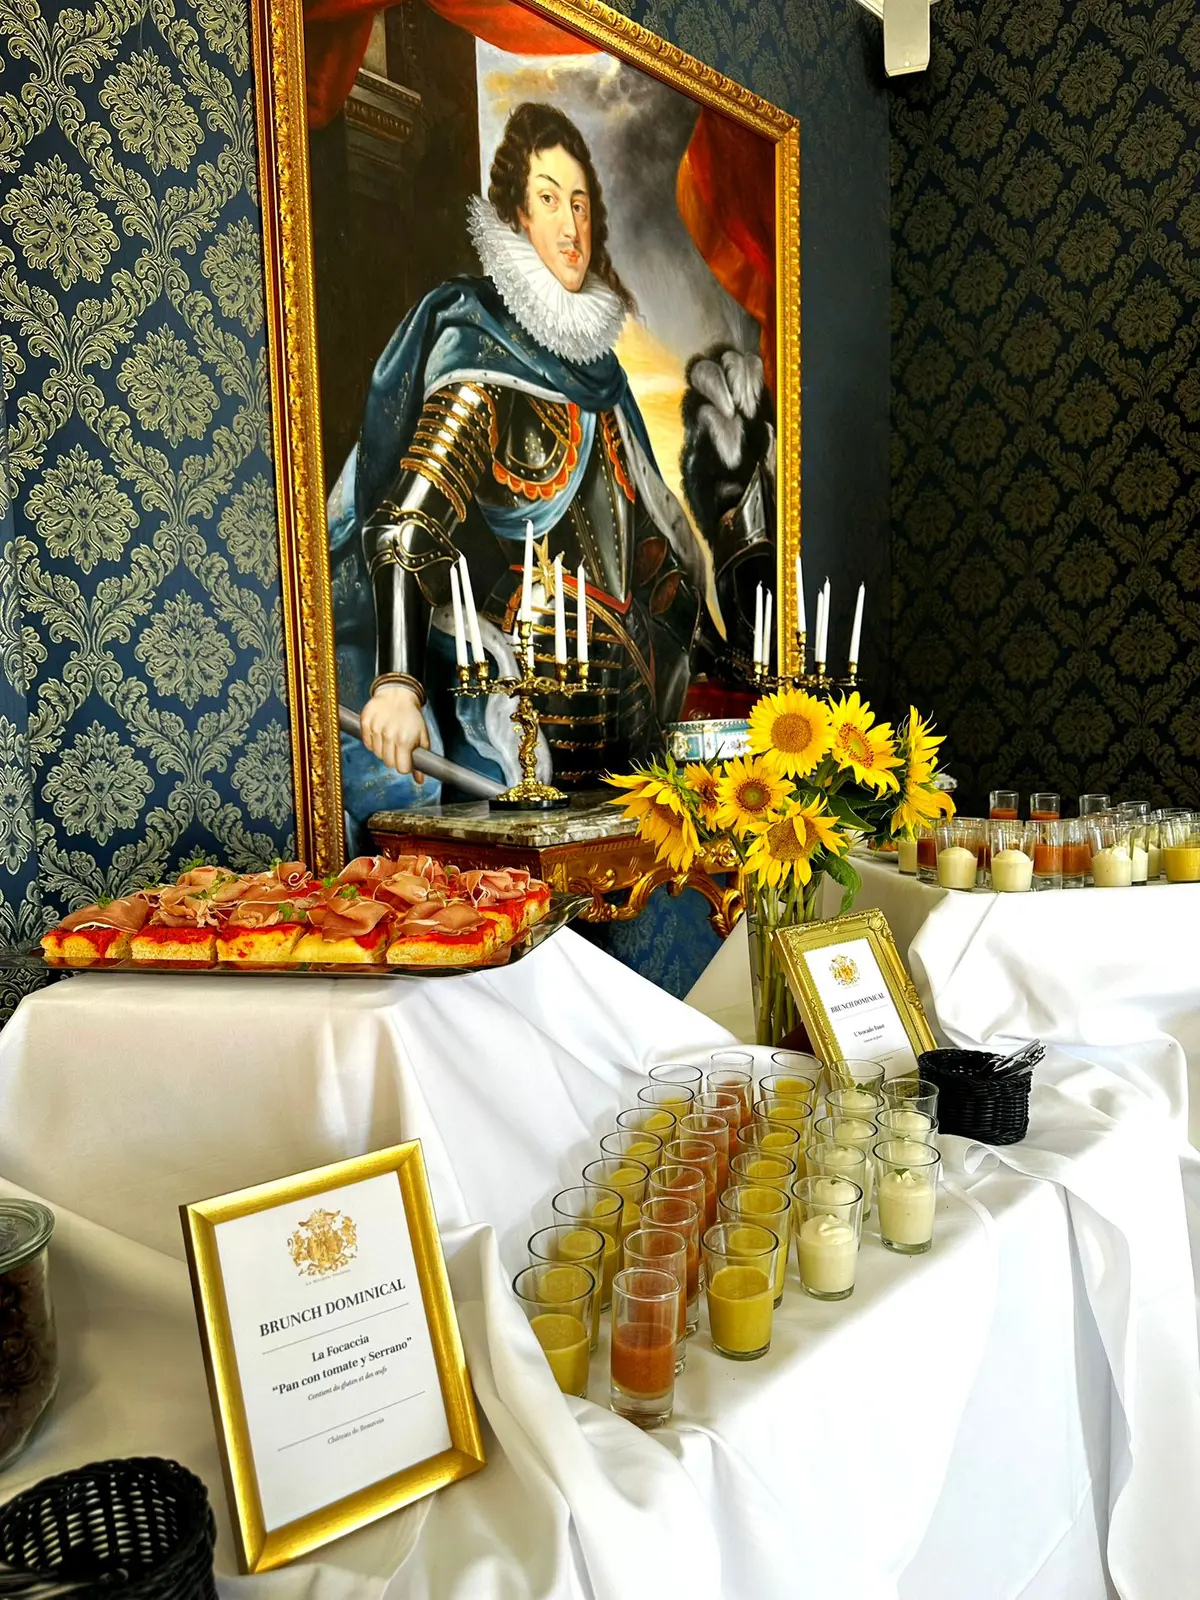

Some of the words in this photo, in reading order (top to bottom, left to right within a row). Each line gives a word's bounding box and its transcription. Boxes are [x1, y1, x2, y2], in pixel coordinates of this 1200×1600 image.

[259, 1305, 323, 1337] BRUNCH
[325, 1277, 406, 1316] DOMINICAL
[312, 1350, 325, 1362] La
[326, 1334, 370, 1358] Focaccia
[301, 1371, 321, 1386] con
[322, 1356, 359, 1379] tomate
[360, 1356, 367, 1368] y
[308, 1387, 333, 1401] Contient
[333, 1384, 341, 1393] du
[341, 1378, 358, 1390] gluten
[364, 1371, 374, 1380] des
[352, 1427, 359, 1435] de
